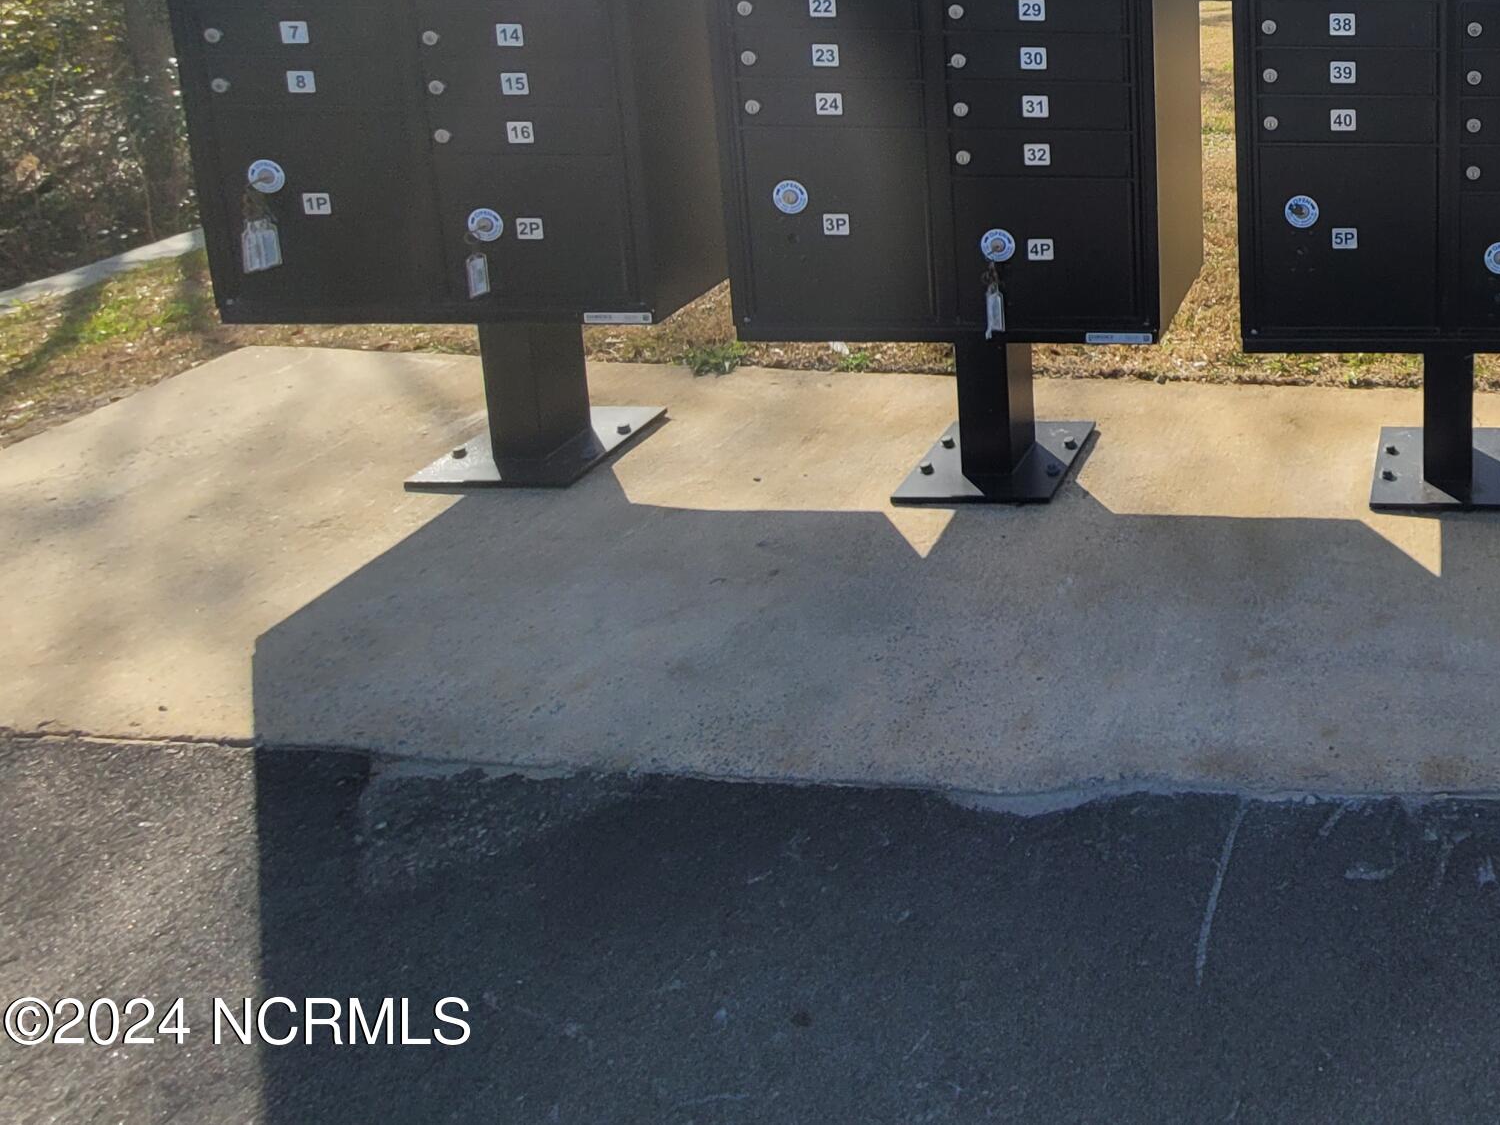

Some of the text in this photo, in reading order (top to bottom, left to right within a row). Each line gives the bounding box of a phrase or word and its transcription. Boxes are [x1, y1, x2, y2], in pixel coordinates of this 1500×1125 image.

[1021, 2, 1042, 18] 29
[287, 24, 299, 40] 7
[1331, 17, 1353, 32] 38
[499, 27, 521, 43] 14
[814, 48, 836, 64] 23
[1023, 51, 1044, 66] 30
[1333, 65, 1353, 80] 39
[295, 74, 307, 90] 8
[504, 76, 526, 92] 15
[818, 96, 840, 112] 24
[1025, 99, 1044, 114] 31
[1332, 112, 1353, 128] 40
[510, 124, 531, 140] 16
[1027, 147, 1047, 162] 32
[305, 196, 328, 211] 1P
[517, 221, 541, 236] 2P
[824, 217, 847, 232] 3P
[1333, 231, 1356, 246] 5P
[1029, 242, 1052, 257] 4P
